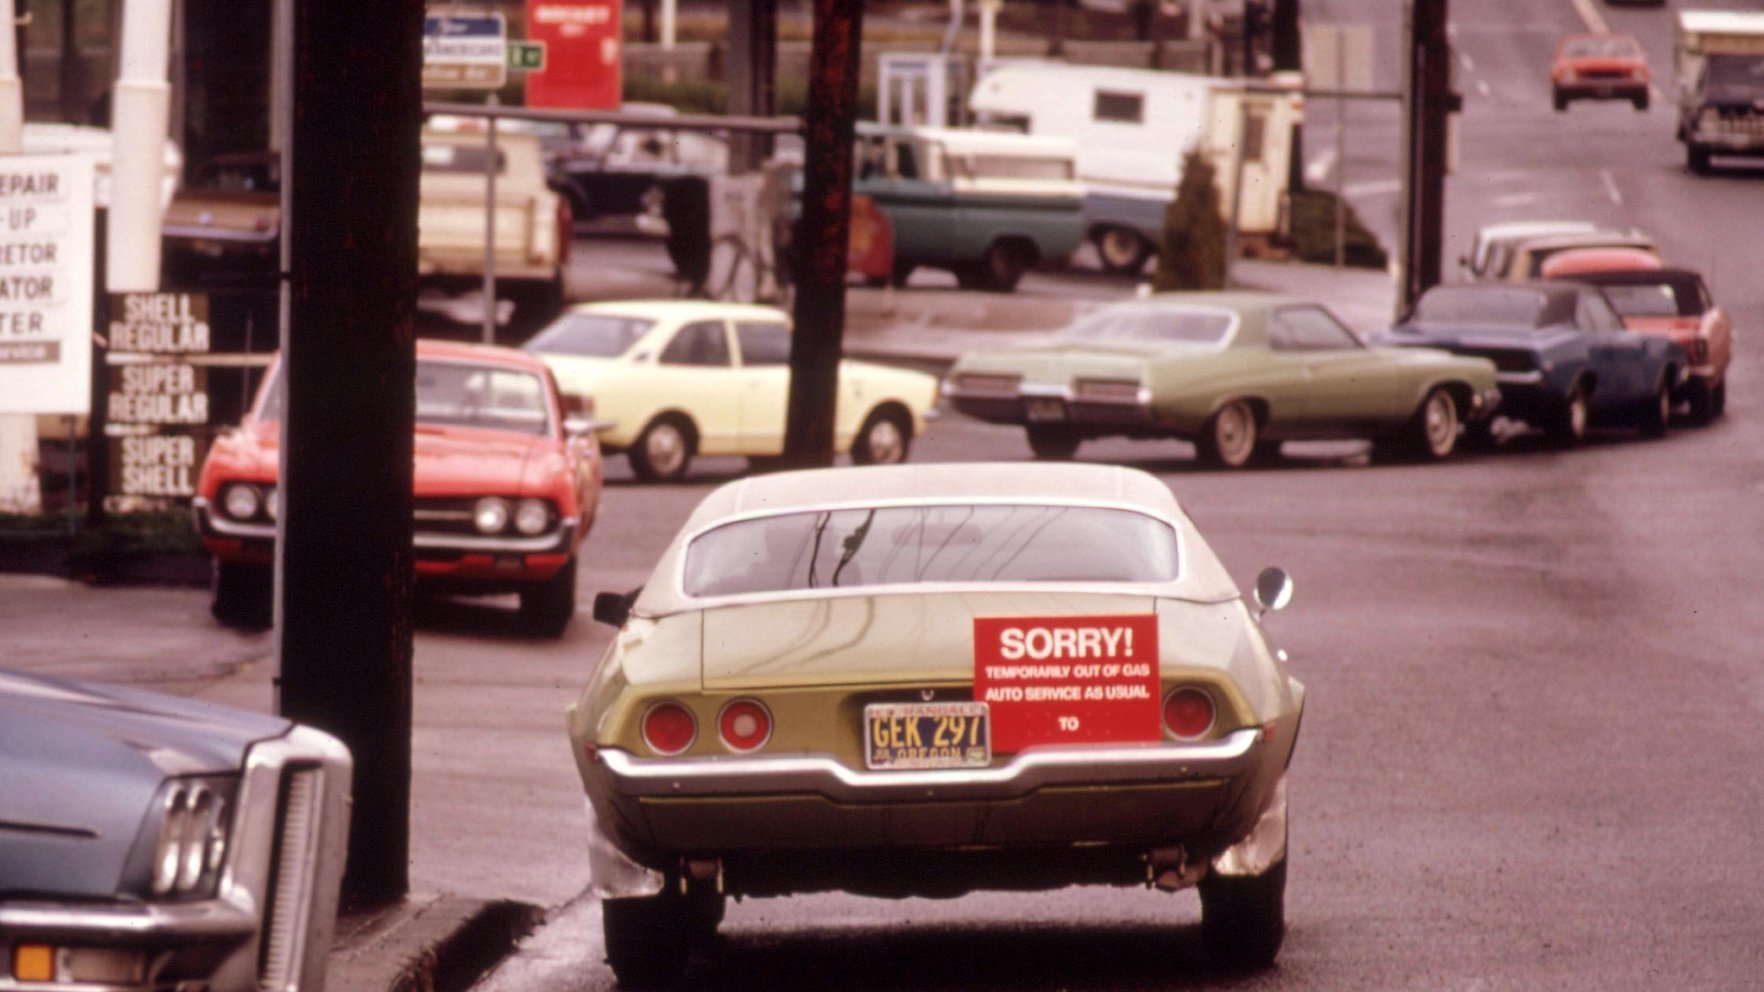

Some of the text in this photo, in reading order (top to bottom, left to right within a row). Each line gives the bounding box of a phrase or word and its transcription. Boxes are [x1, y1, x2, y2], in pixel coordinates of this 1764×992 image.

[0, 173, 59, 194] EPAIR
[0, 276, 53, 300] ATOR
[125, 293, 197, 322] SHELL
[109, 321, 210, 351] REGULAR
[122, 364, 194, 394] SUPER
[108, 392, 208, 422] REGULAR
[122, 436, 194, 466] SUPER
[122, 465, 194, 495] SHELL
[1000, 627, 1133, 660] SORRY!
[985, 663, 1150, 679] TEMPORARILY OUT OF GAS
[985, 685, 1150, 701] AUTO SERVICE AS USUAL
[873, 714, 980, 748] GEK 297
[1058, 716, 1079, 731] TO
[896, 746, 961, 759] OREGON
